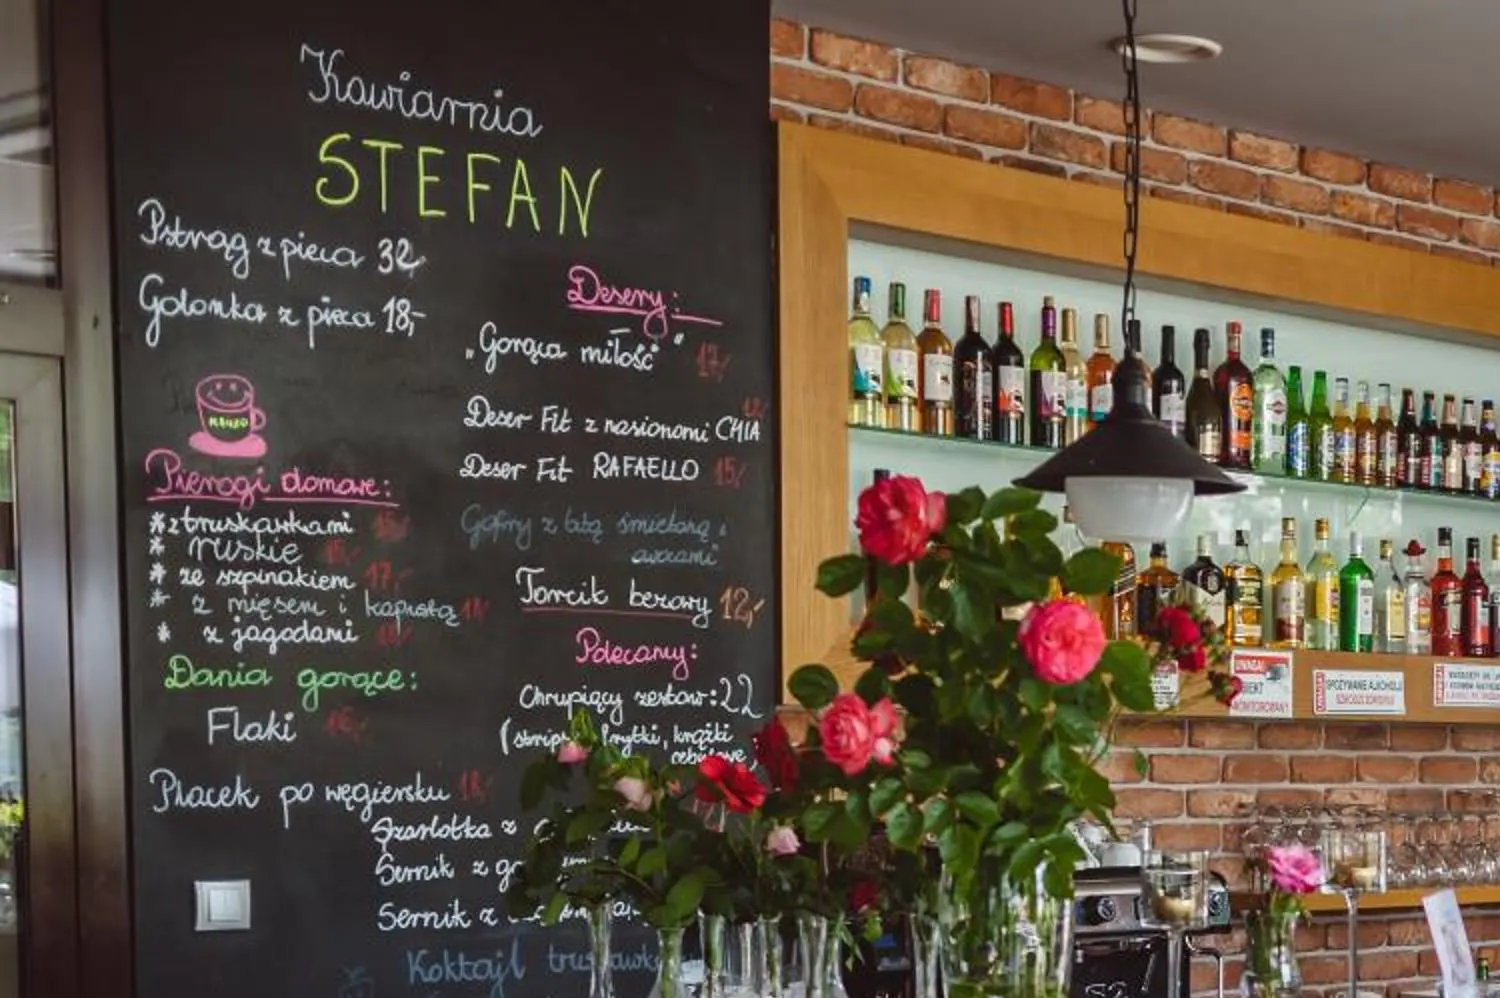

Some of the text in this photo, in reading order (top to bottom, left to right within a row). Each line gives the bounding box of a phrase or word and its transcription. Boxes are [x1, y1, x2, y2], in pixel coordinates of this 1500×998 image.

[300, 44, 543, 137] Kawiarnia
[316, 133, 601, 238] STEFAN
[138, 199, 249, 279] Pstrąg
[257, 236, 276, 257] z
[139, 273, 268, 347] Golonka
[278, 305, 300, 326] z
[464, 395, 532, 428] Deser
[541, 405, 572, 433] Fit
[585, 417, 599, 433] z
[715, 416, 760, 443] CHIA
[145, 448, 272, 511] Pierogi
[460, 453, 527, 481] Deser
[536, 457, 573, 482] Fit
[592, 451, 699, 481] RAFAELLO
[461, 503, 533, 550] Gofry
[541, 517, 557, 535] z
[179, 568, 206, 587] ze
[216, 567, 356, 595] szpinakiem
[515, 567, 609, 607] Torcik
[193, 597, 213, 614] z
[339, 594, 348, 614] i
[203, 624, 224, 644] z
[232, 614, 359, 654] jagodami
[165, 654, 273, 689] Dania
[519, 684, 624, 726] Chrupiący
[207, 706, 297, 745] Flaki
[149, 767, 260, 813] Placek
[279, 782, 314, 829] po
[371, 816, 493, 851] Szarlotka
[502, 819, 517, 834] z
[376, 852, 454, 886] Sernik
[472, 861, 489, 876] z
[377, 899, 471, 931] Sernik
[480, 908, 499, 926] z
